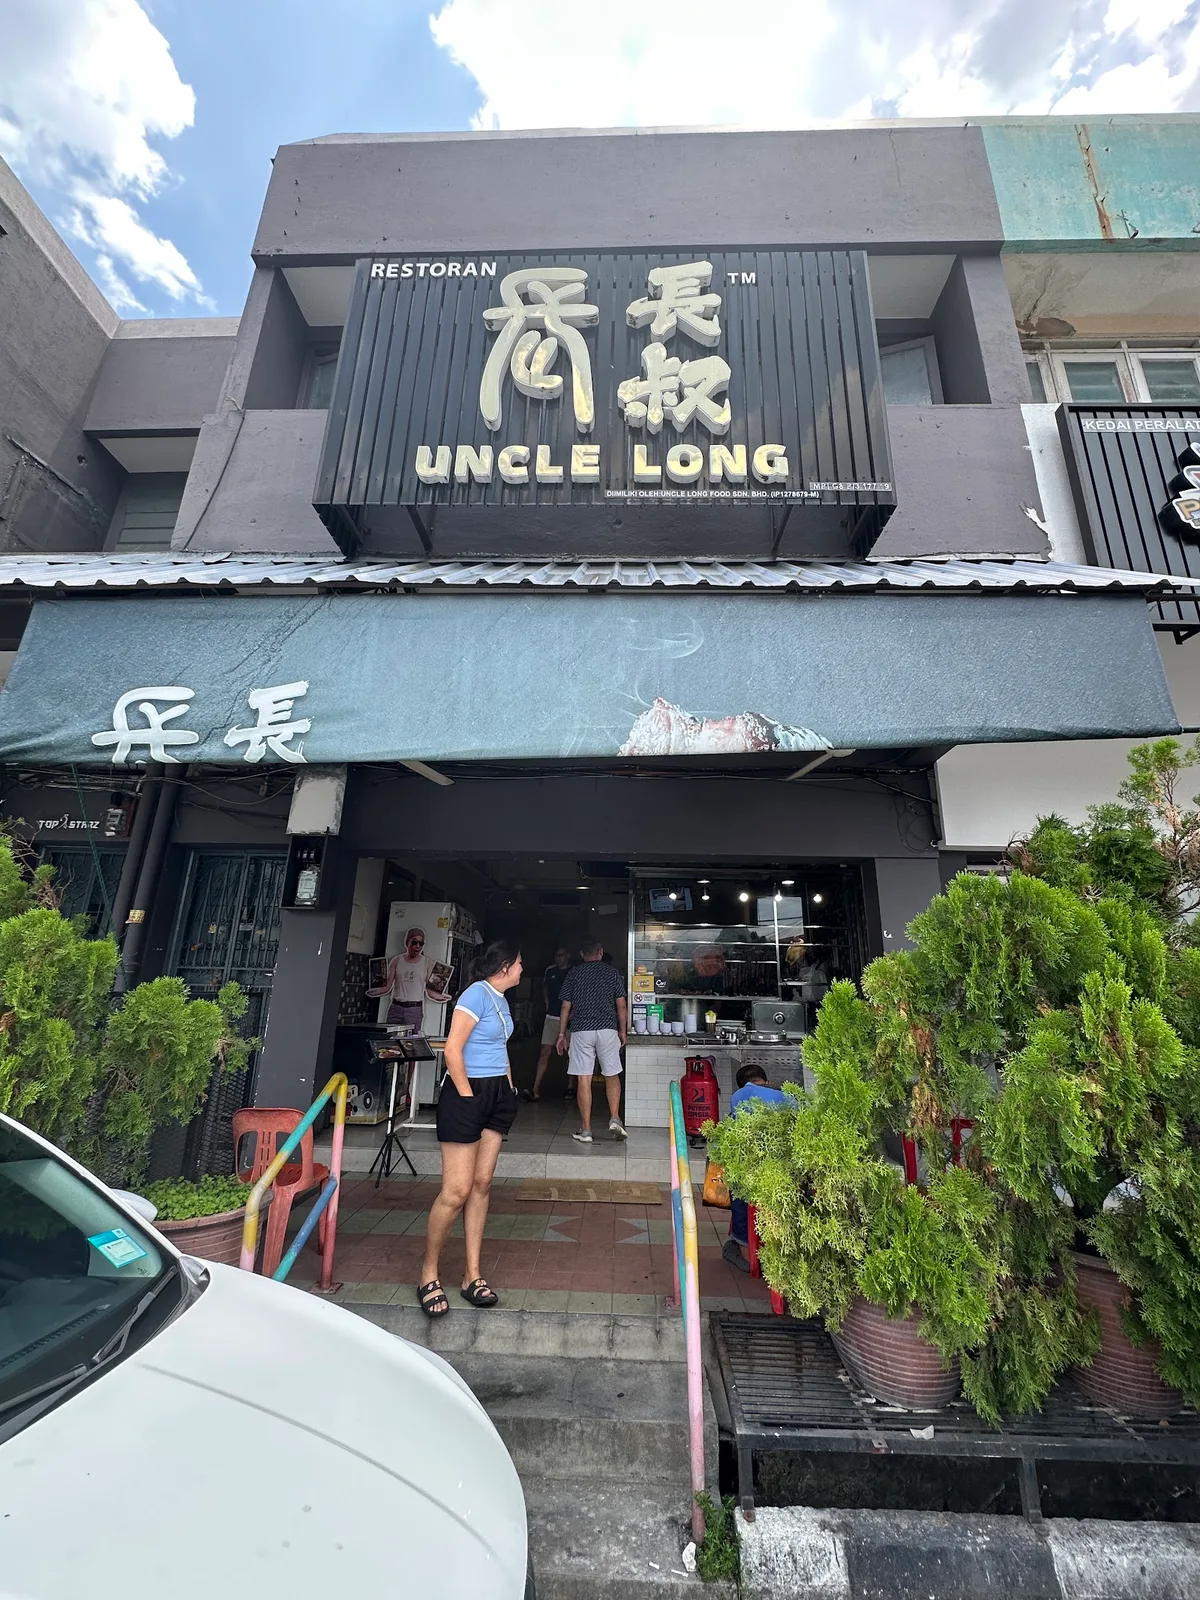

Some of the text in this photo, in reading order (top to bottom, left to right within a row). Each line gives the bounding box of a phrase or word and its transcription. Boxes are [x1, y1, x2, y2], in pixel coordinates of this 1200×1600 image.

[371, 262, 497, 278] RESTORAN
[727, 272, 757, 285] TM
[1085, 420, 1131, 431] KEDAI
[414, 444, 790, 484] UNCLE LONG
[687, 490, 708, 498] LONG
[709, 490, 731, 498] FOOD
[732, 490, 750, 498] SDN.
[751, 490, 769, 498] BHD.
[39, 820, 100, 829] TOP STARZ
